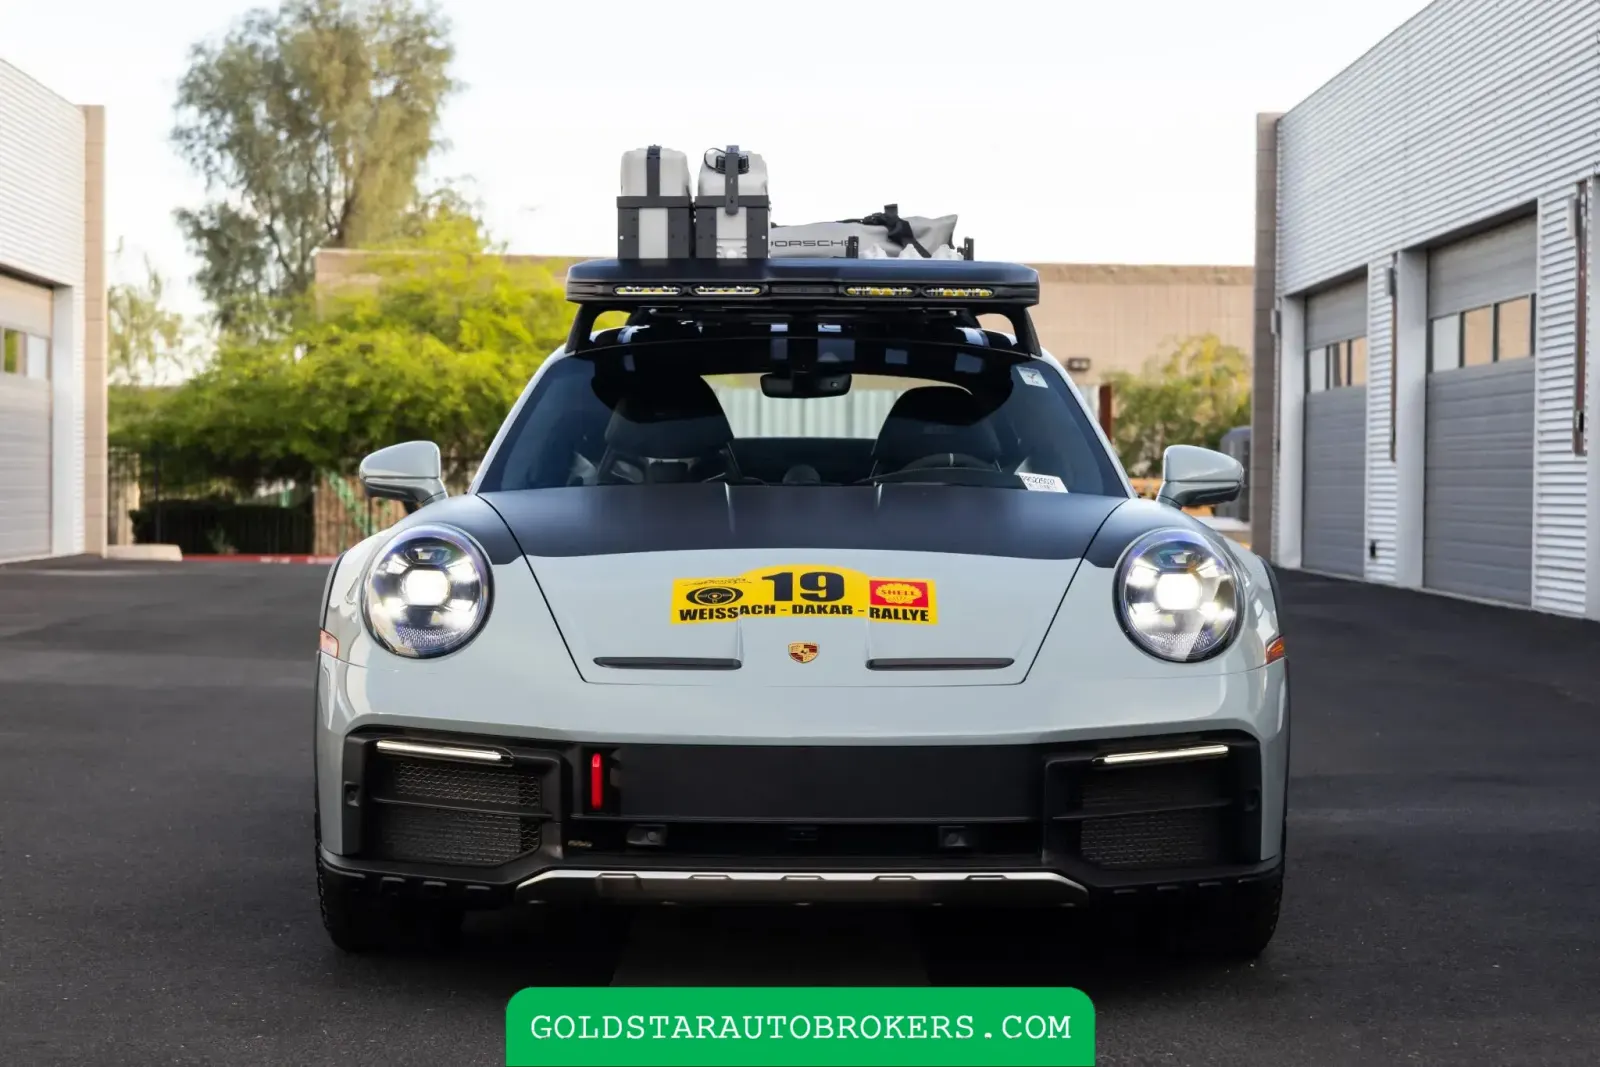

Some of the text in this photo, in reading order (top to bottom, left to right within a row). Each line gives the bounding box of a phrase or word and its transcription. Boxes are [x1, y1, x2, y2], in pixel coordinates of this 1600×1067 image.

[761, 571, 845, 602] 19
[679, 604, 776, 621] WEISSACH
[792, 604, 853, 615] DAKAR
[869, 606, 929, 622] RALLYE
